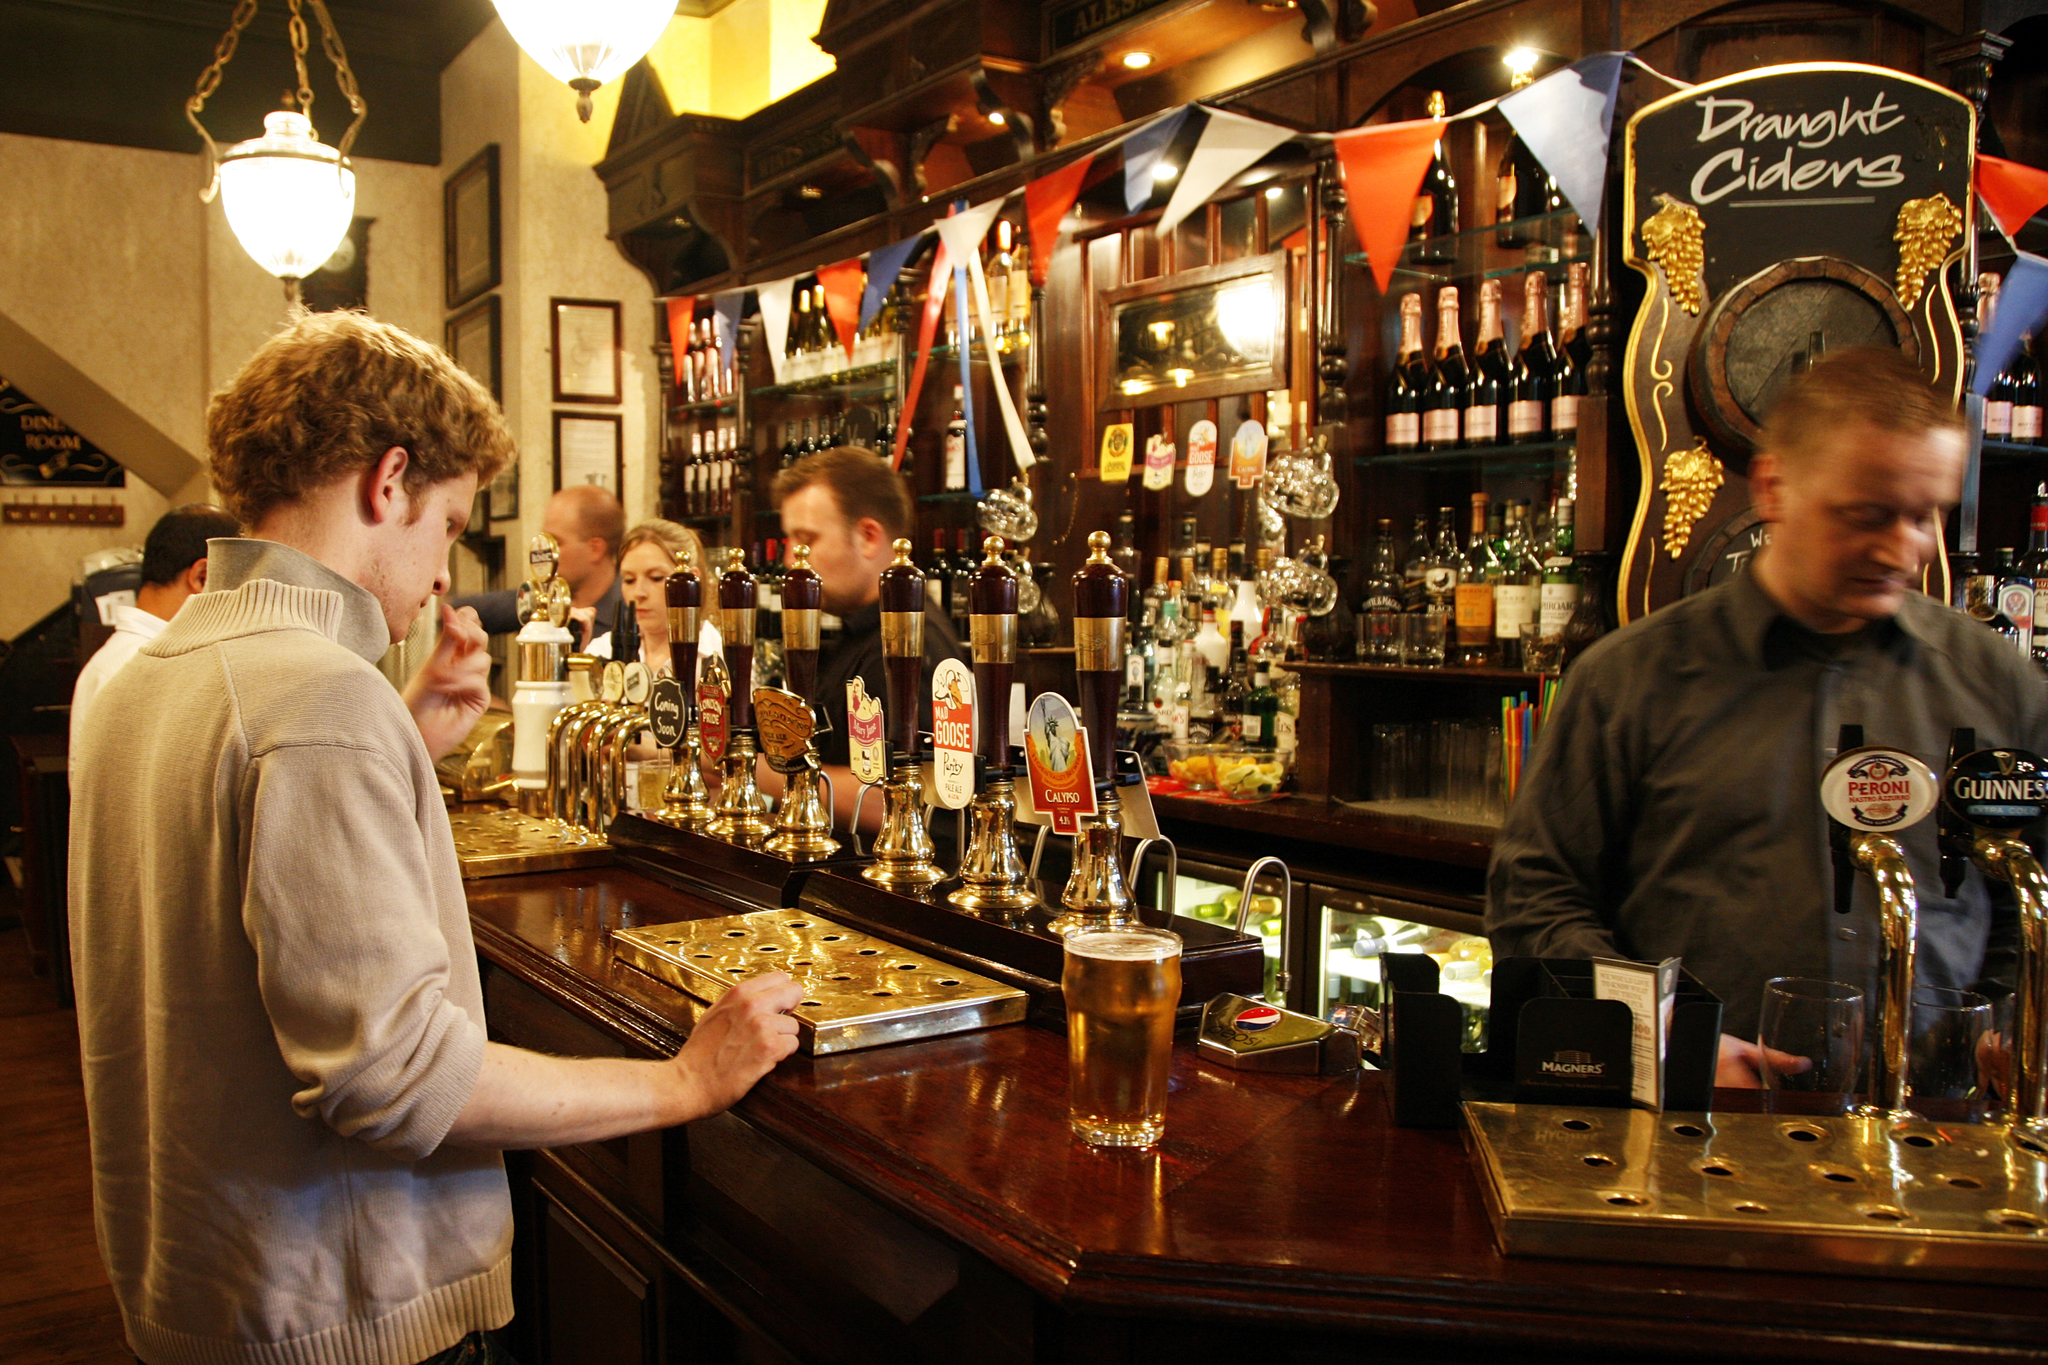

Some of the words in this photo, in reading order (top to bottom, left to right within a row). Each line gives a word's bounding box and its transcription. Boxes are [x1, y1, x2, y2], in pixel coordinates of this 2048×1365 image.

[1695, 91, 1905, 148] Draught
[1690, 147, 1905, 204] Ciders
[25, 433, 81, 451] ROOM
[1189, 450, 1213, 464] GOOSE
[1428, 604, 1454, 612] BLACK
[654, 692, 679, 720] Coming
[699, 698, 722, 715] LONDON
[935, 706, 948, 720] MAD
[657, 716, 676, 737] Soon
[703, 712, 720, 725] PRIDE
[935, 720, 970, 749] GOOSE
[943, 752, 963, 778] Purity
[945, 782, 954, 792] PALE
[1848, 781, 1910, 796] PERONI
[1954, 776, 2048, 800] GUINNES
[1045, 789, 1080, 803] CALYPSO
[1877, 794, 1911, 802] AZZURRO
[1970, 806, 2004, 814] EXTRA
[2008, 807, 2038, 815] COLD
[1208, 1024, 1266, 1046] pepsi
[1542, 1061, 1602, 1074] MAGNERS
